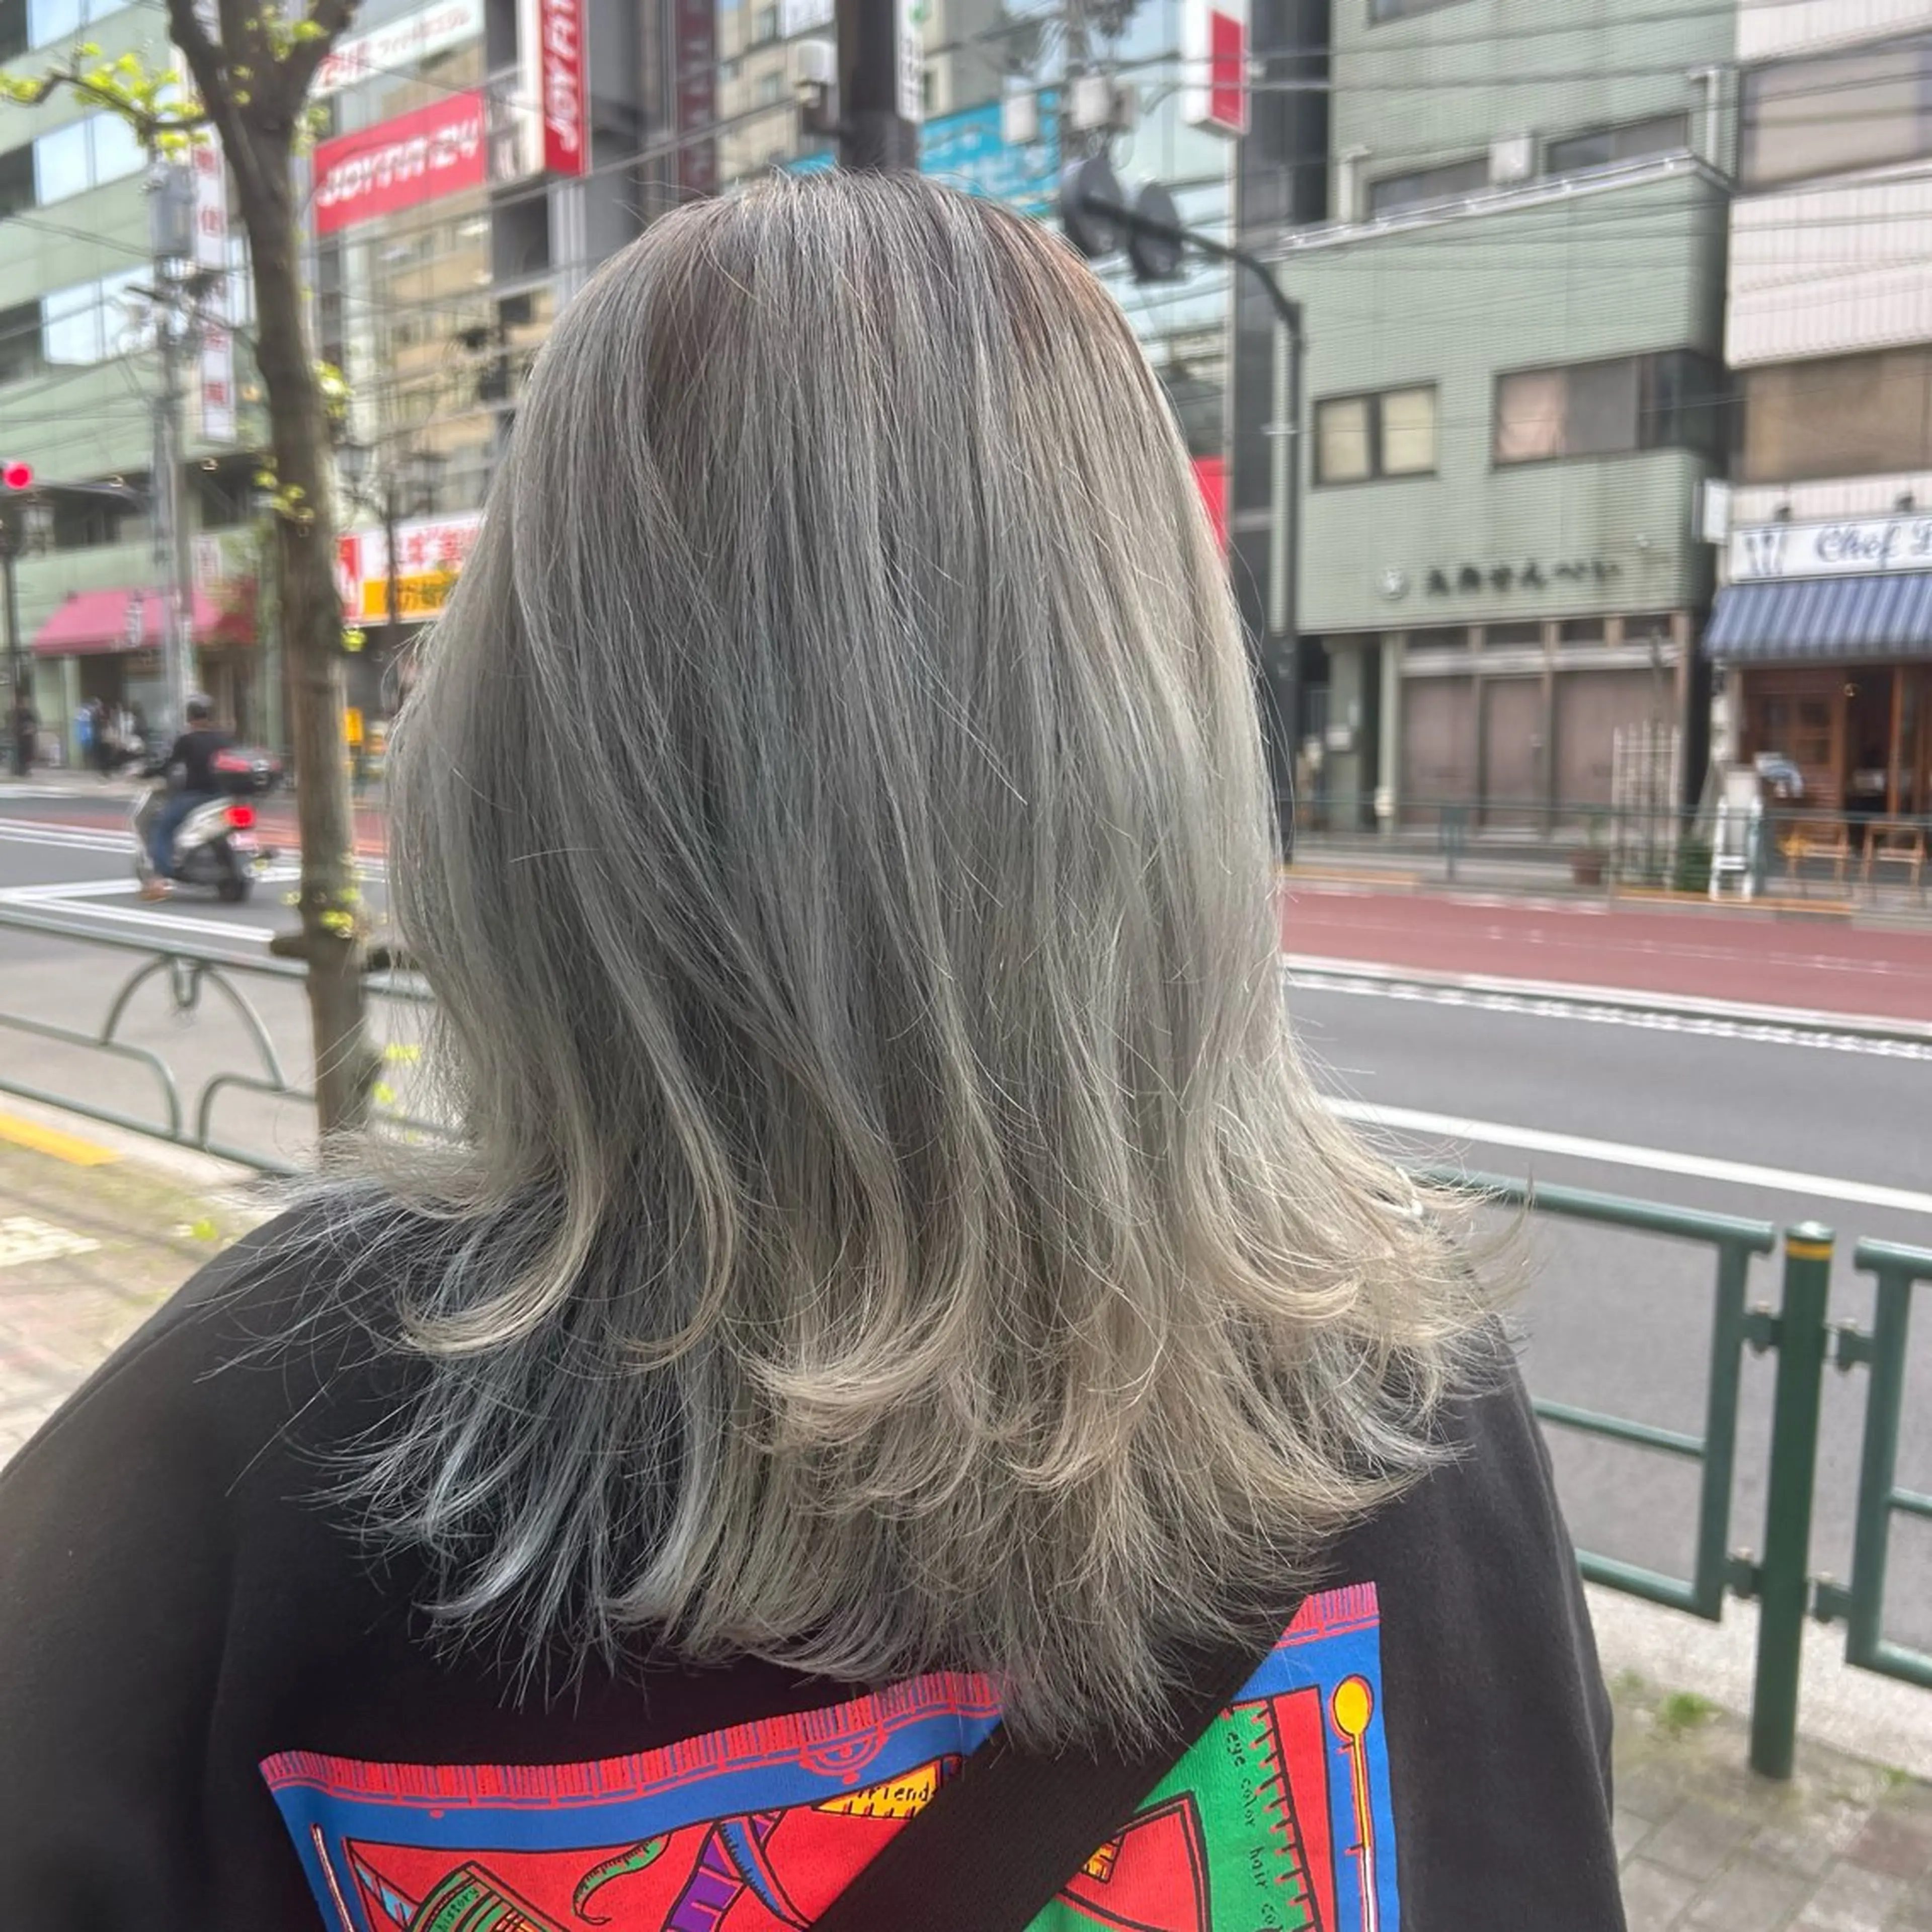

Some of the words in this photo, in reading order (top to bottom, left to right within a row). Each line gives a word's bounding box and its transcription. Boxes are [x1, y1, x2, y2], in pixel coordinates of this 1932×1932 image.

[1814, 522, 1901, 570] Chef
[1227, 1732, 1246, 1767] eye
[1241, 1778, 1257, 1827] color
[1249, 1846, 1270, 1890] hair
